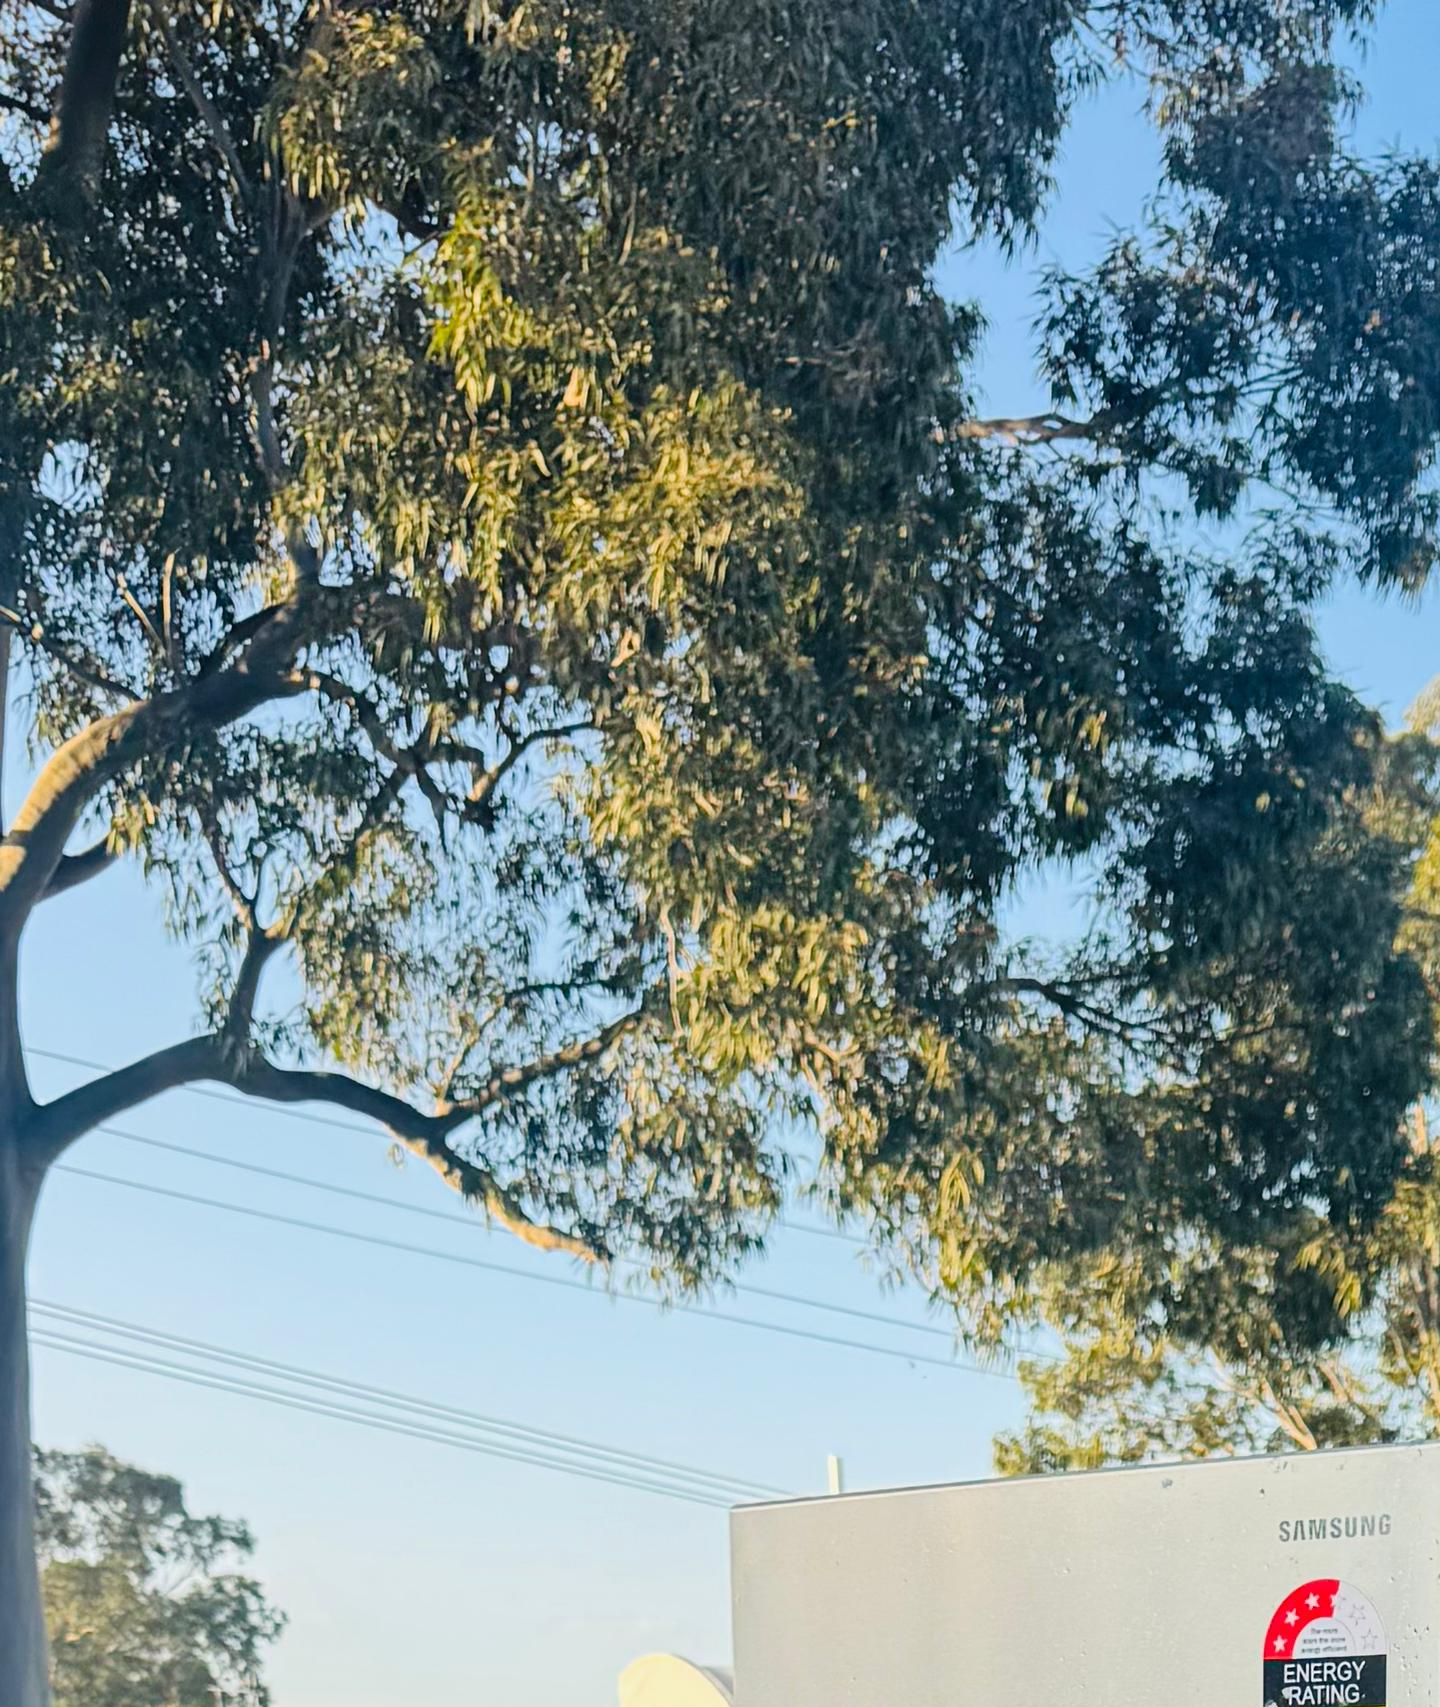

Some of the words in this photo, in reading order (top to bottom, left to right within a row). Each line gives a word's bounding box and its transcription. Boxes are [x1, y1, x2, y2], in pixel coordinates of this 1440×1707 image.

[1279, 1514, 1391, 1542] SAMSUNG
[1284, 1660, 1366, 1684] ENERGY
[1288, 1683, 1361, 1706] RATING
